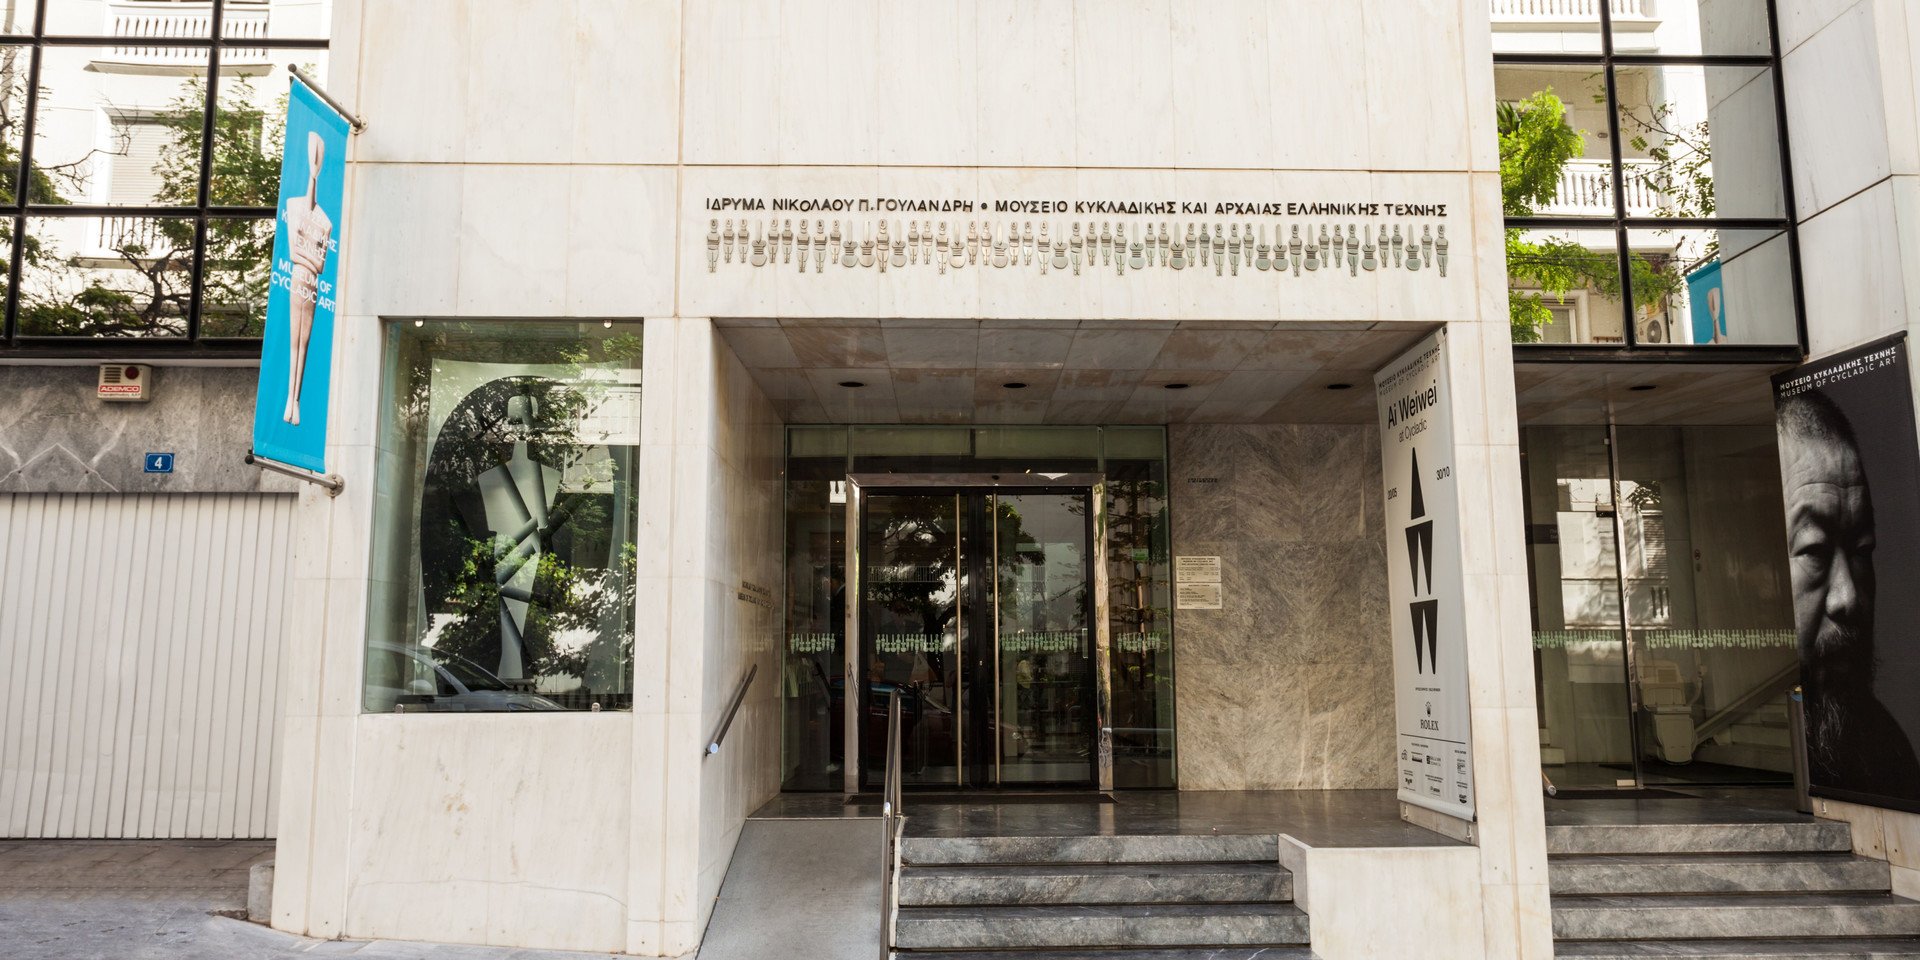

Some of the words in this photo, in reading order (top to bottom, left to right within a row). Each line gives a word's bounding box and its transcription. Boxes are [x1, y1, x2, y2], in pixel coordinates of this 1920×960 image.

[706, 198, 766, 211] ΙΔΡΥΜΑ
[772, 198, 854, 212] ΝΙΚΟΛΑΟΥ
[995, 200, 1068, 213] ΜΟΥΣΕΙΟ
[1075, 201, 1177, 215] ΚΥΚΛΑΔΙΚΗΣ
[1182, 202, 1207, 214] ΚΑΙ
[1214, 202, 1282, 215] ΑΡΧΑΙΑΣ
[1287, 203, 1379, 216] ΕΛΛΗΝΙΚΗΣ
[1384, 203, 1447, 217] ΤΕΧΝΗΣ
[271, 271, 317, 303] CYCLADIC
[318, 295, 337, 313] ART
[320, 280, 333, 295] OF
[1780, 375, 1811, 391] ΜΟΥΣΕΙΟ
[1813, 359, 1861, 380] ΚΥΚΛΑΔΙΚΗΣ
[1864, 346, 1896, 363] ΤΕΧΝΗΣ
[1780, 383, 1813, 398] MUSEUM
[1816, 378, 1827, 388] OF
[1830, 362, 1875, 383] CYCLADIC
[1879, 355, 1896, 368] ART
[1388, 403, 1397, 430] Ai
[1398, 379, 1438, 422] Weiwei
[1398, 429, 1404, 443] at
[1404, 418, 1427, 442] Cycladic
[154, 456, 163, 469] 4
[1420, 719, 1439, 731] ROLEX
